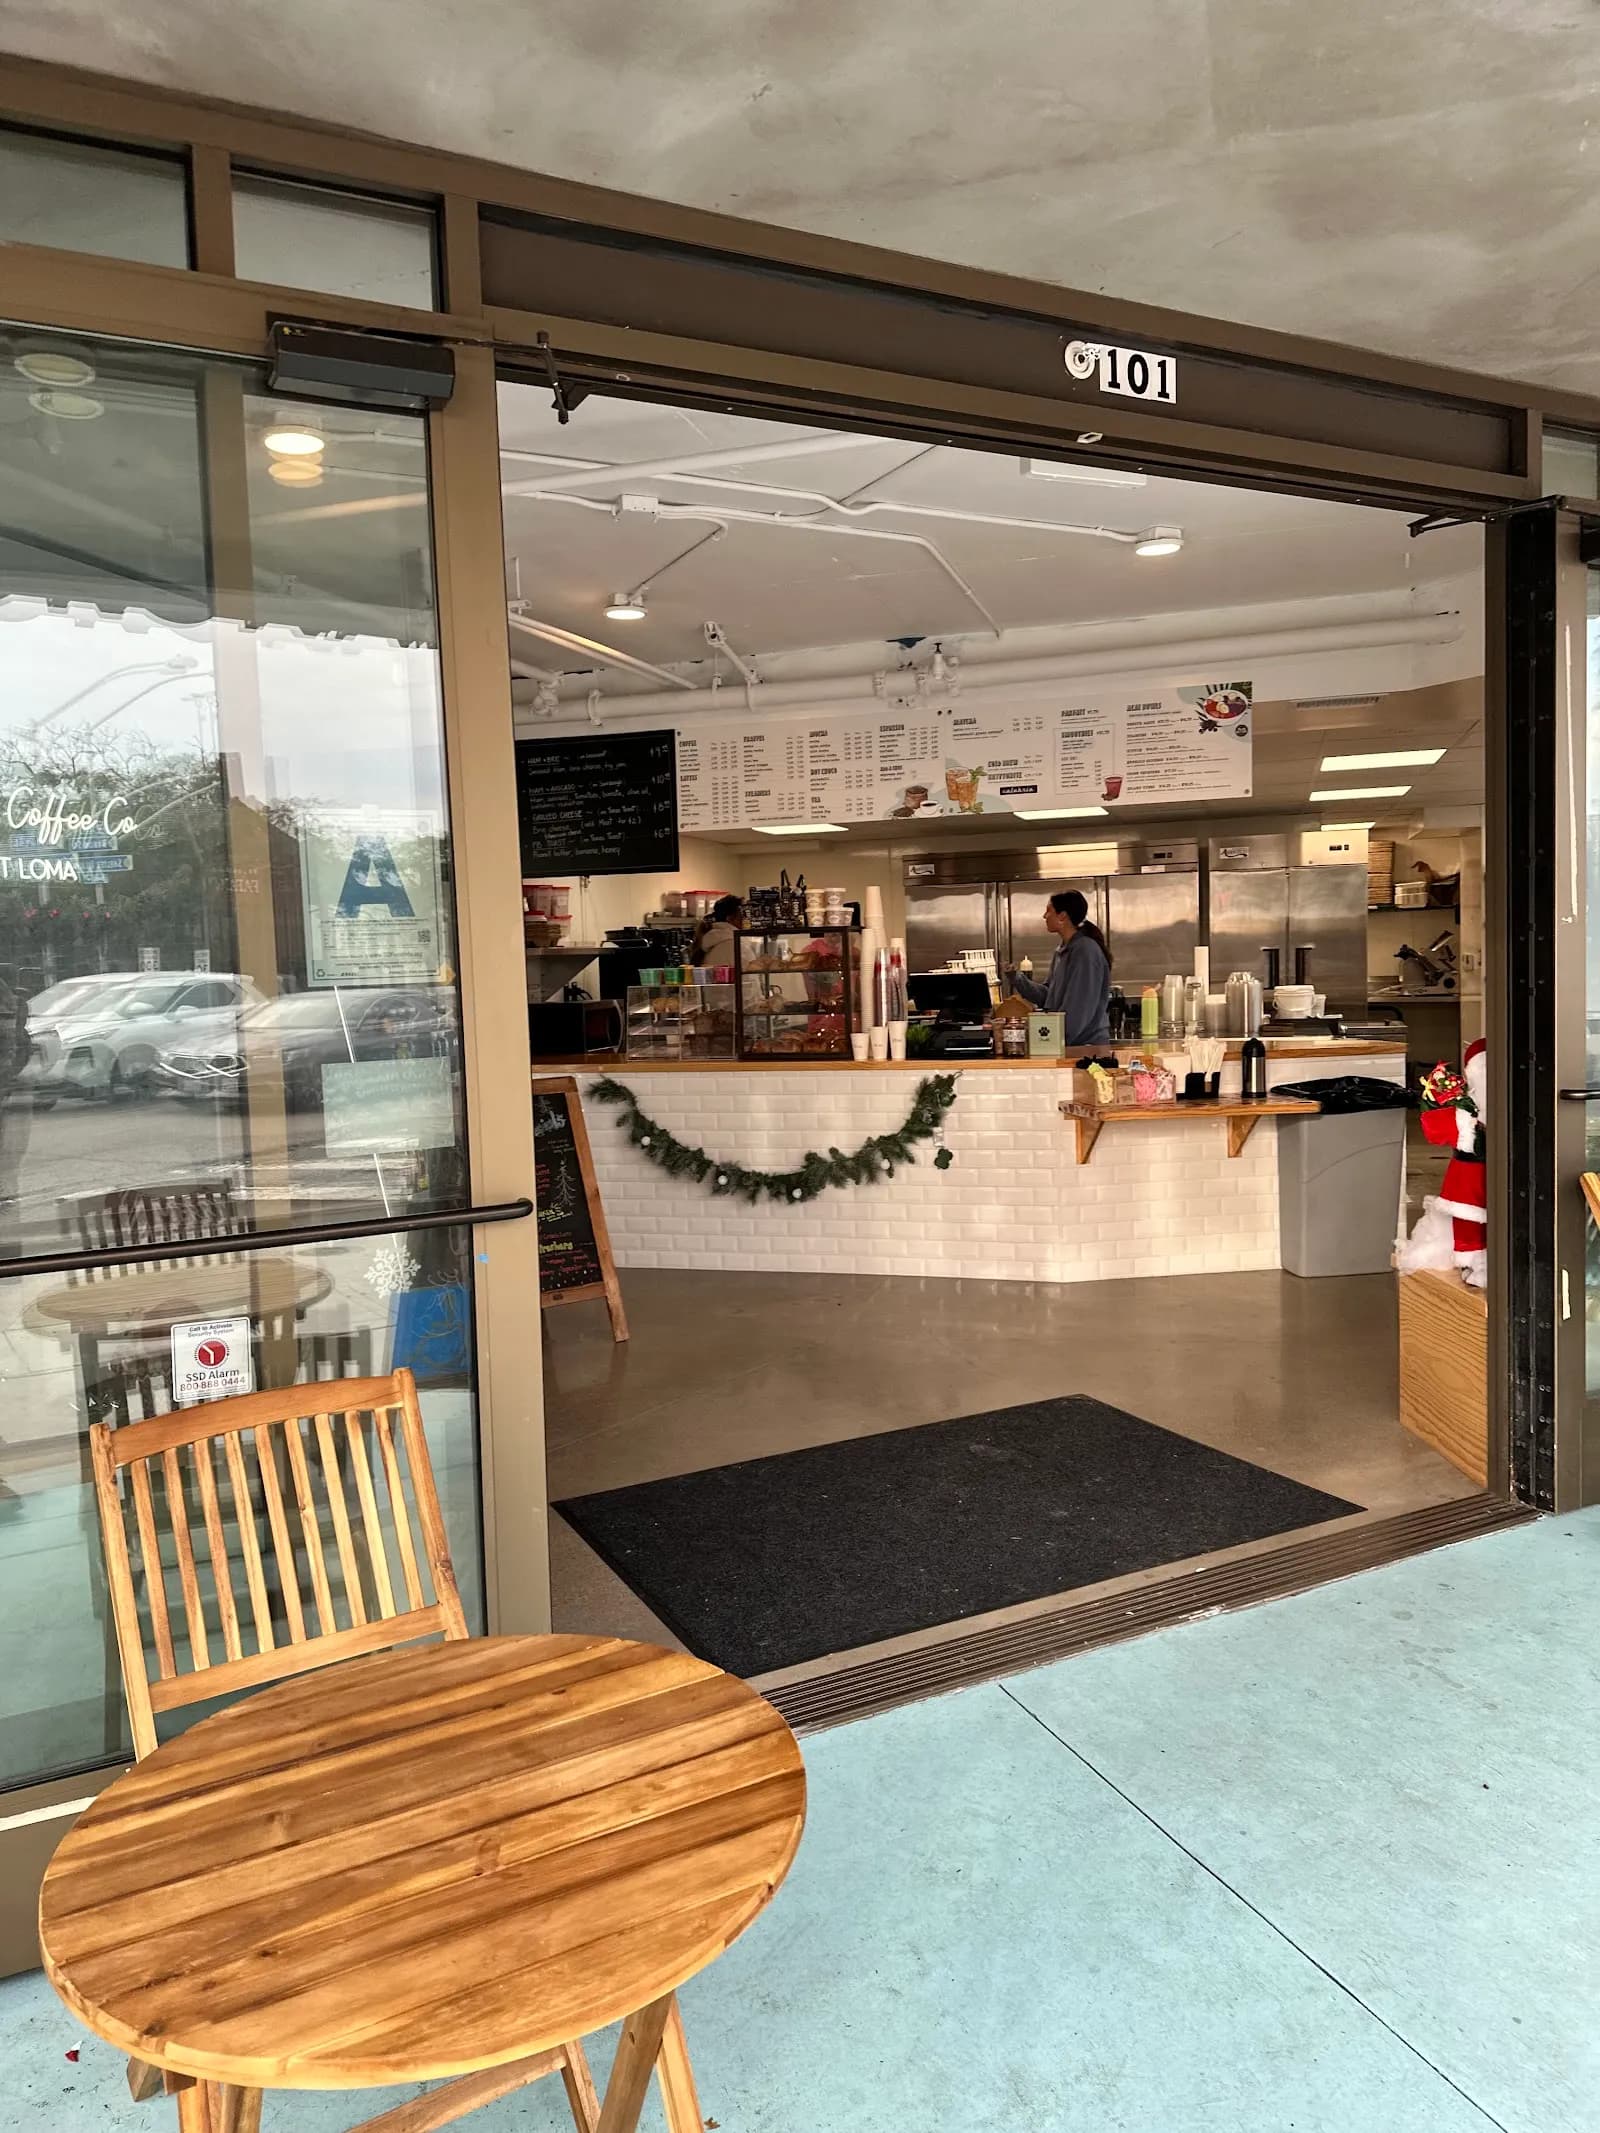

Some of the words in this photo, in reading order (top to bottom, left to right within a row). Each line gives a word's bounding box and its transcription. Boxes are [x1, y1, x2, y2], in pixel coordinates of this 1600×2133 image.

[1107, 349, 1170, 399] 101
[6, 786, 98, 845] Coffee
[18, 857, 78, 881] LOMA
[334, 835, 416, 919] A
[186, 1373, 206, 1383] SSD
[209, 1369, 240, 1380] Alarm
